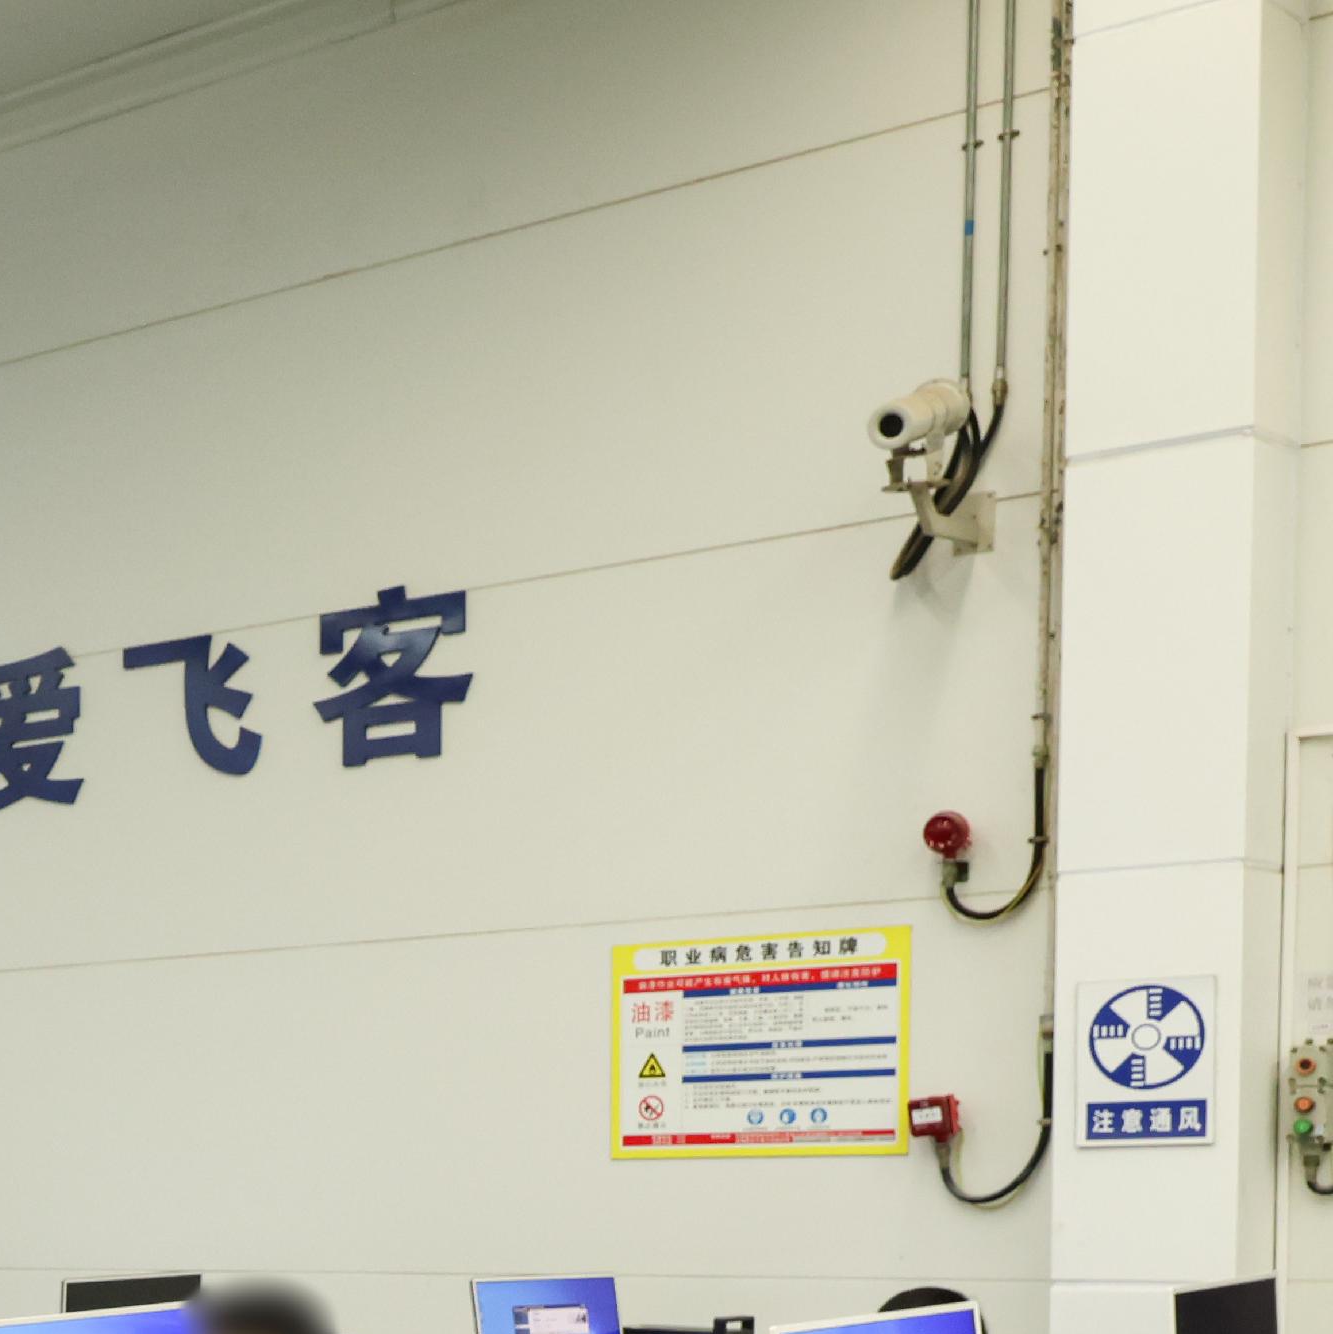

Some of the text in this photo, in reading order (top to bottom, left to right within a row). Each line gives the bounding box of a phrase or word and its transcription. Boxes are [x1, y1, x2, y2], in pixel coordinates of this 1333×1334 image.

[660, 936, 858, 967] 职业病危害告知牌
[632, 1000, 674, 1023] 油漆
[635, 1027, 670, 1039] Paint
[1092, 1105, 1202, 1135] 注意通风
